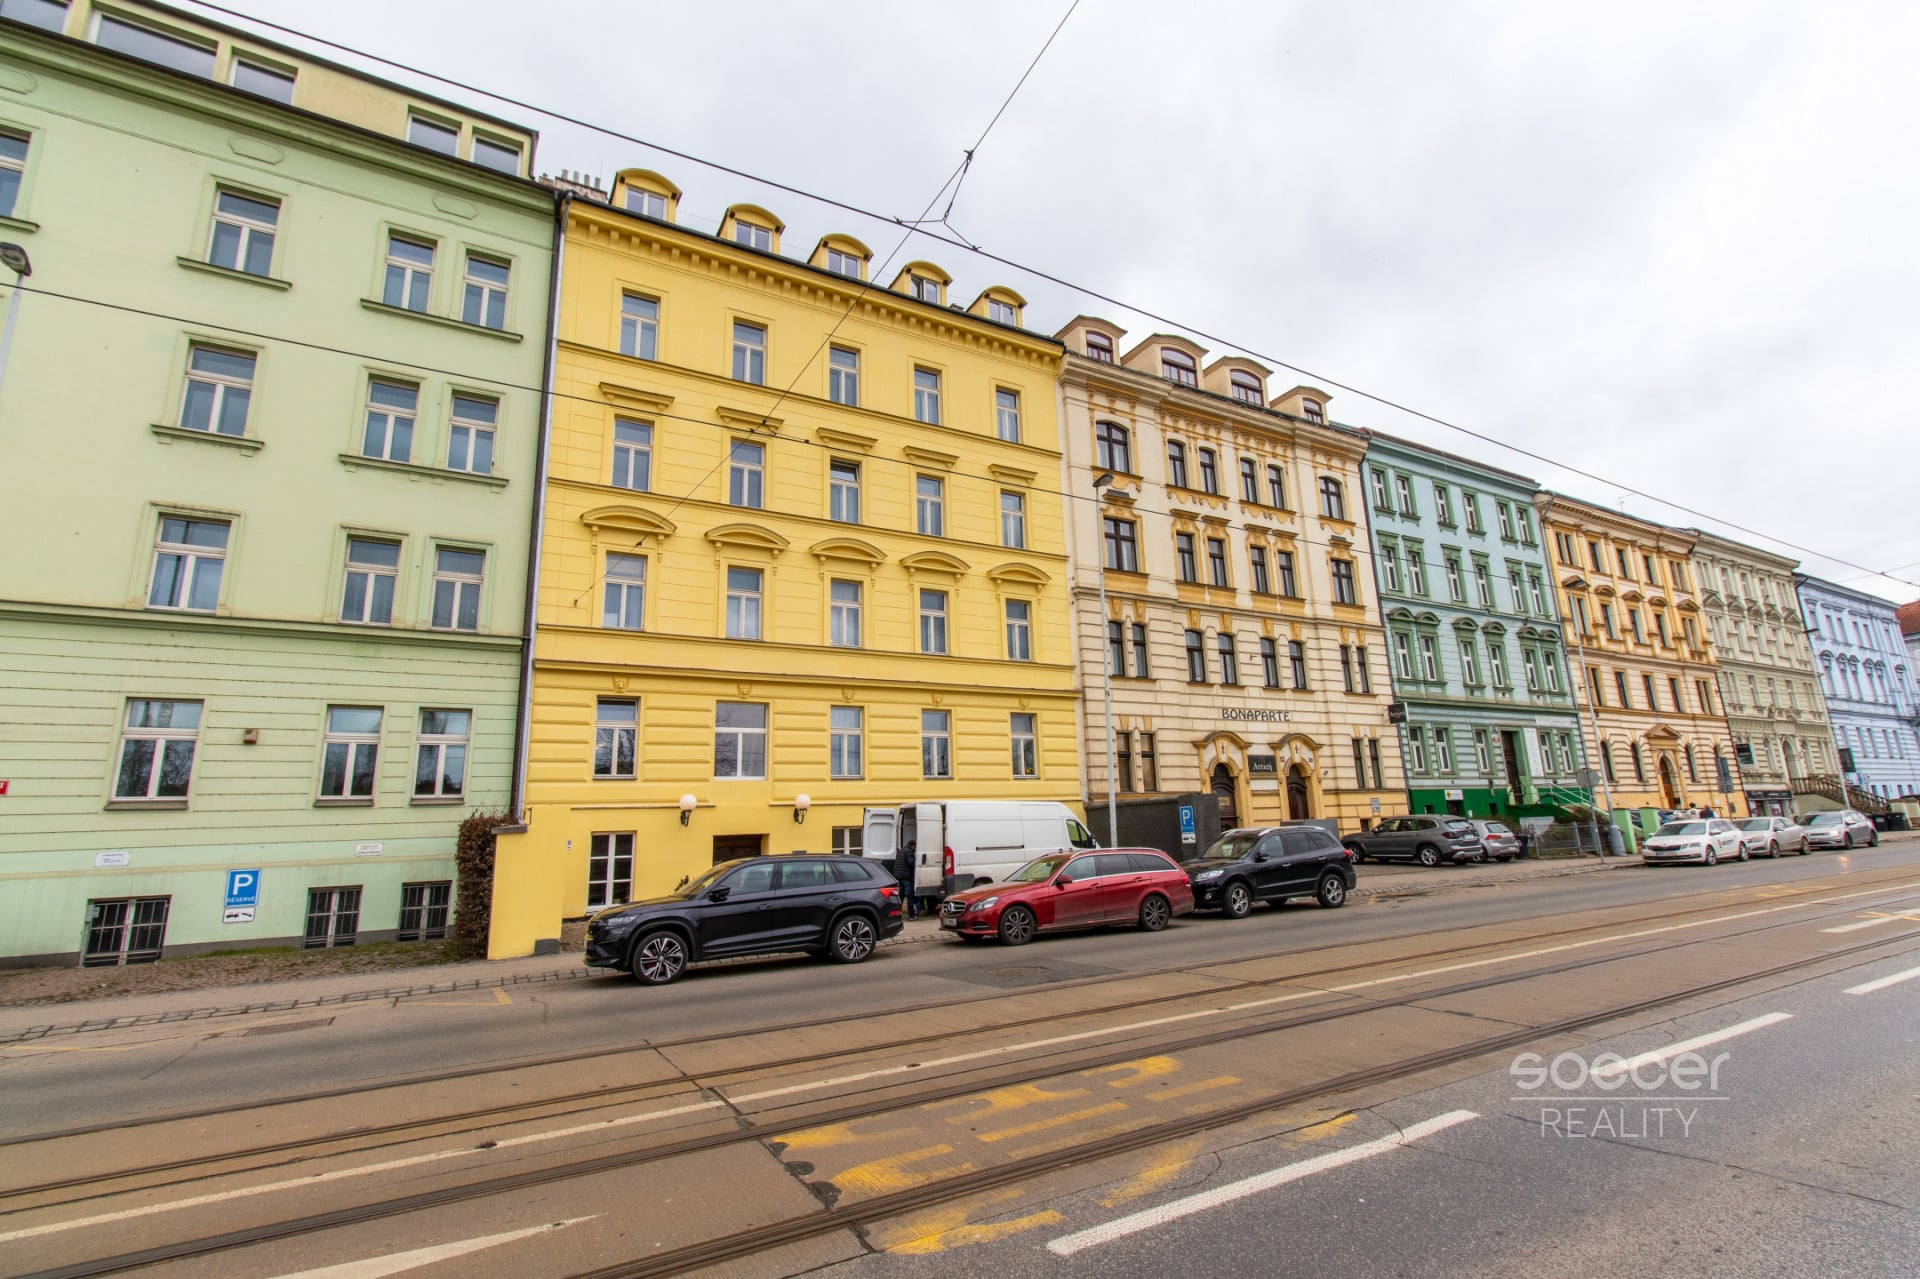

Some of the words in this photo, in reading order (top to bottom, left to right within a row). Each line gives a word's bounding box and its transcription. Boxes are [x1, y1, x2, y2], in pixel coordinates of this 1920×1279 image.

[1222, 708, 1291, 722] BONAPARTE
[1182, 809, 1191, 825] P
[232, 873, 254, 896] P
